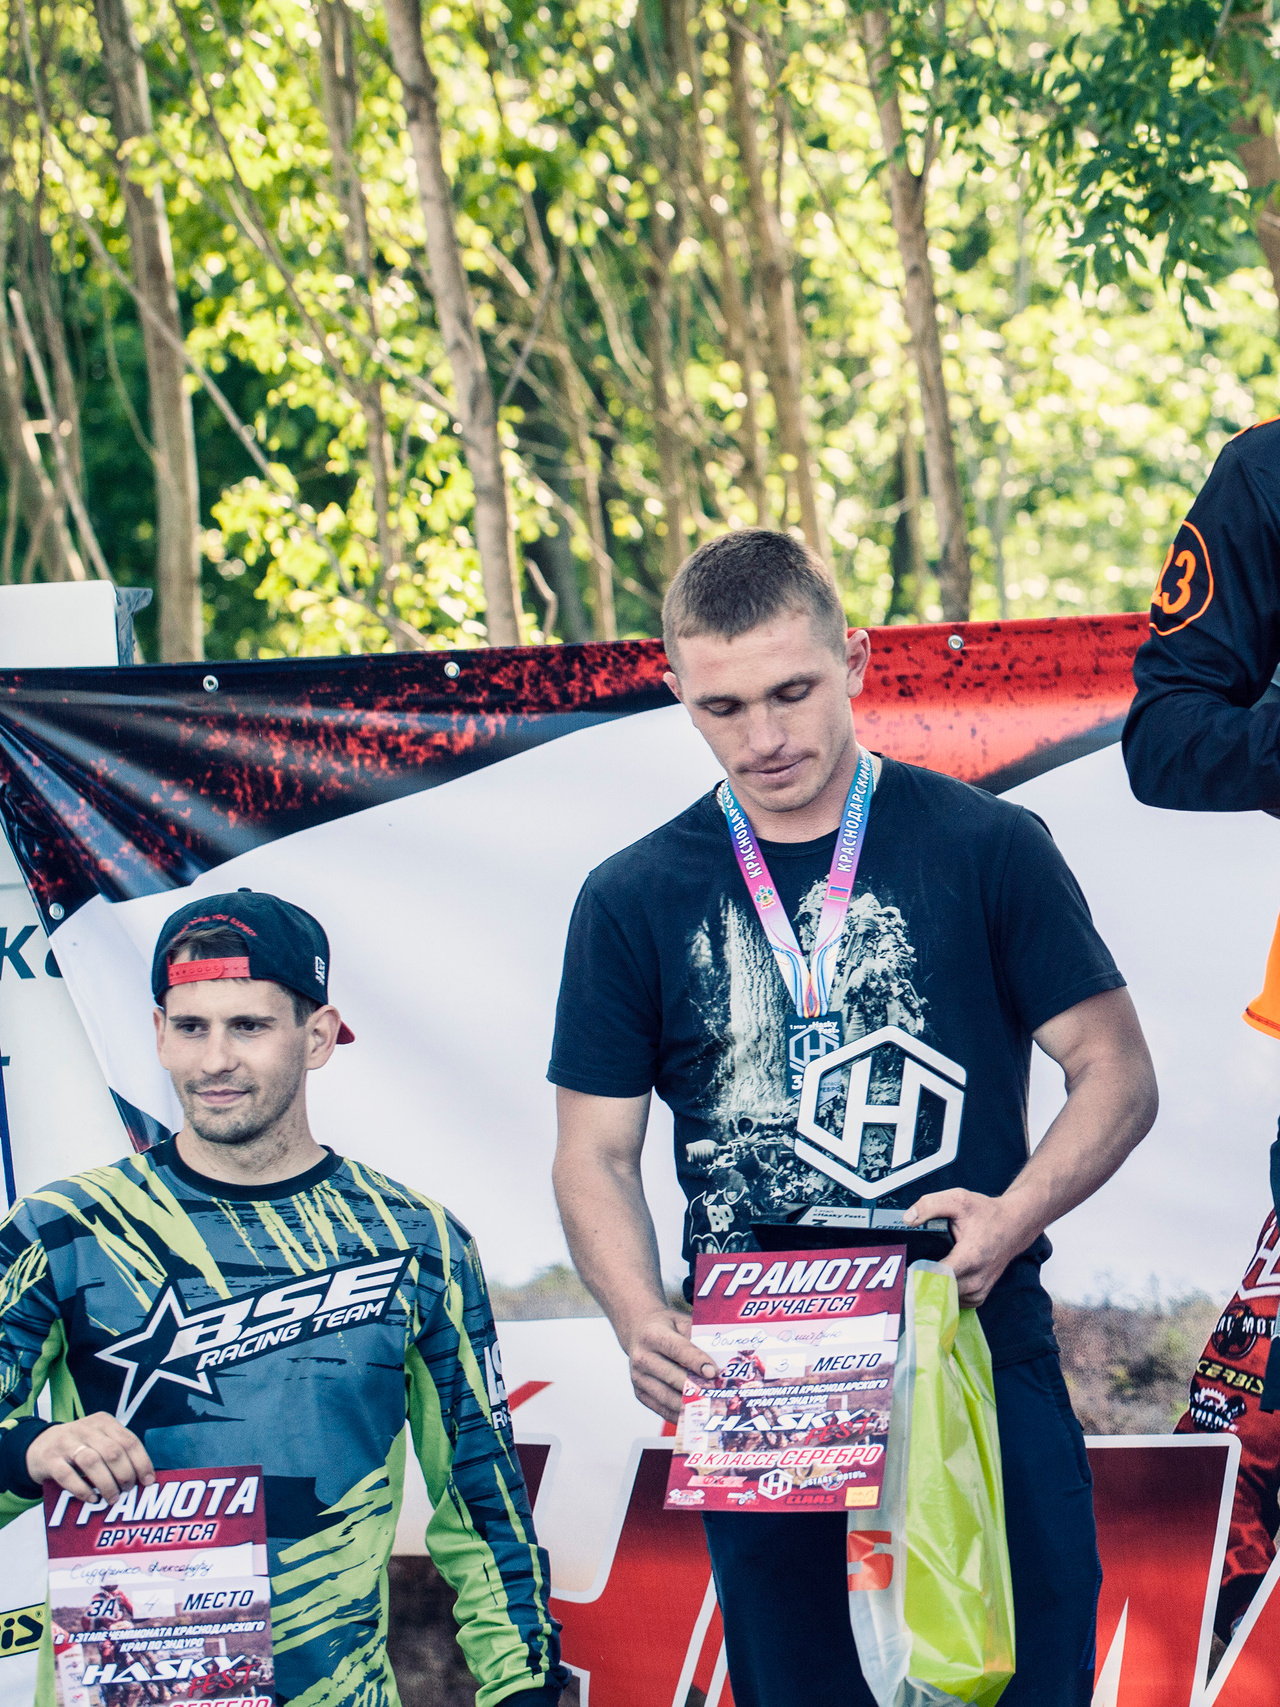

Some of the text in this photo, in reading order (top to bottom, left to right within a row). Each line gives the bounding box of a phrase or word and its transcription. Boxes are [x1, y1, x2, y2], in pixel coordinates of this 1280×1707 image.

[697, 1254, 902, 1298] ГРАМОТА
[740, 1296, 857, 1317] ВРУЧАЕТСЯ
[197, 1301, 387, 1371] RACING TEAM
[722, 1362, 751, 1378] ЗА
[812, 1353, 882, 1373] МЕСТО
[738, 1384, 799, 1398] ЧЕМПИОНАТА
[798, 1379, 889, 1395] КРАСНОДАРСКОГО
[788, 1394, 828, 1406] ЭНДУРО
[704, 1408, 866, 1431] HASKY
[803, 1415, 878, 1446] FEST
[686, 1446, 881, 1466] В КЛАССЕ СЕРЕБРО
[48, 1476, 259, 1527] ГРАМОТА
[96, 1522, 218, 1548] ВРУЧАЕТСЯ
[87, 1599, 116, 1617] ЗА
[182, 1590, 254, 1611] МЕСТО
[108, 1626, 172, 1641] ЧЕМПИОНАТА
[172, 1620, 266, 1637] КРАСНОДАРСКОГО
[162, 1637, 205, 1650] ЭНДУРО
[82, 1654, 247, 1686] HASKY
[187, 1663, 261, 1698] FEST
